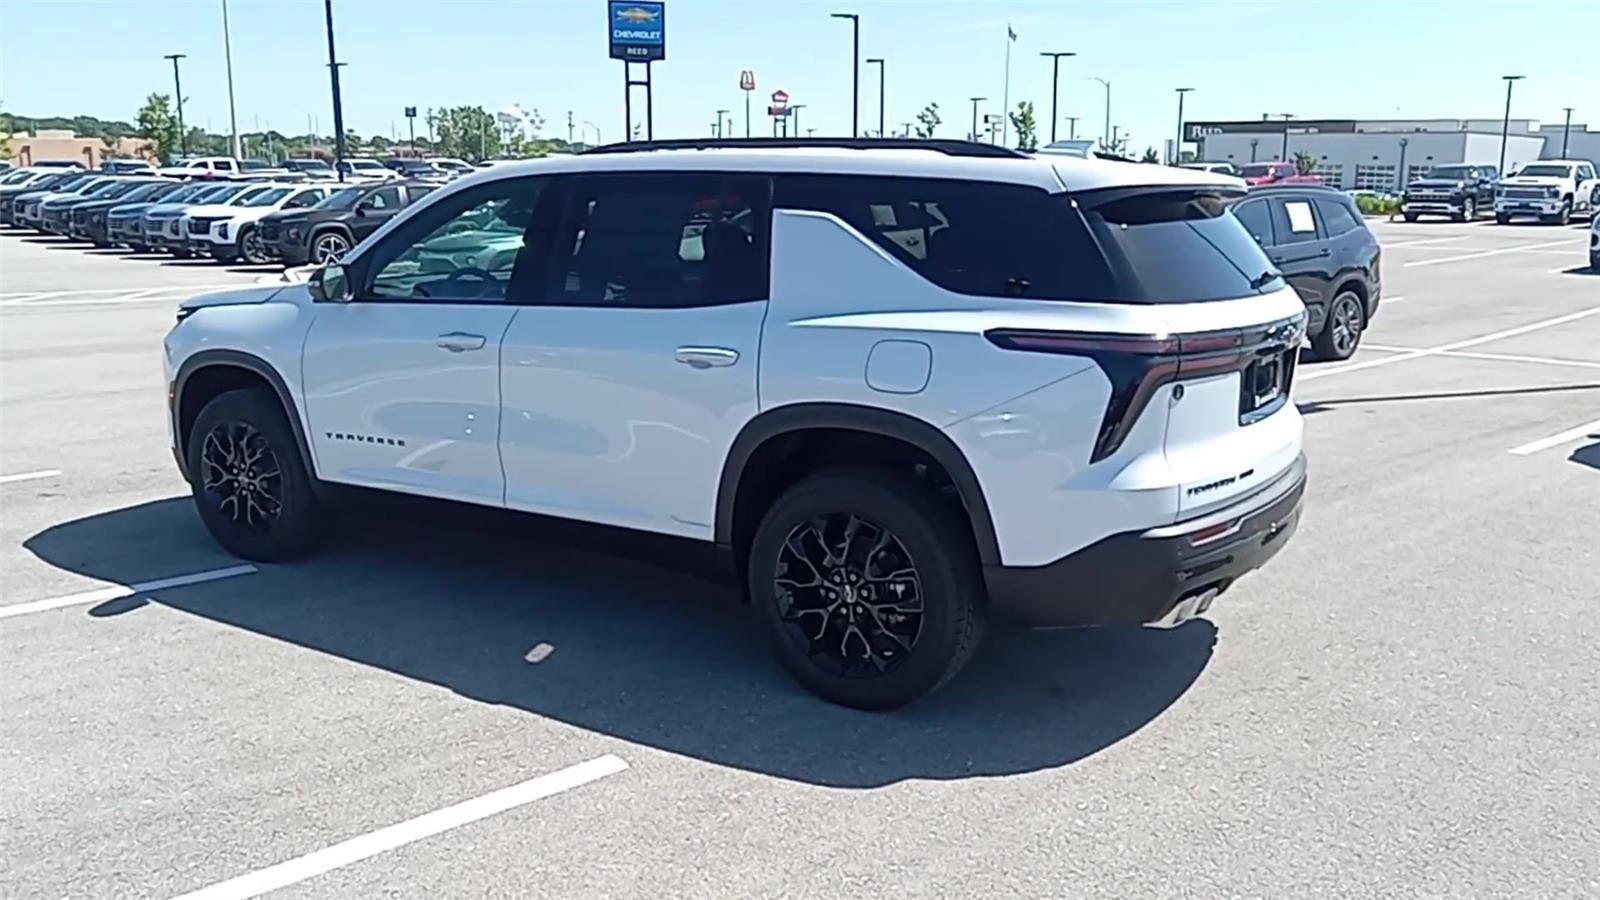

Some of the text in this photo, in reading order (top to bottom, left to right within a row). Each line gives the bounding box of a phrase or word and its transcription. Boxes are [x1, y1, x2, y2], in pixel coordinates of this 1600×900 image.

[613, 30, 660, 39] CHEVROLET
[627, 47, 649, 55] REED
[325, 432, 406, 447] TRAVERSE
